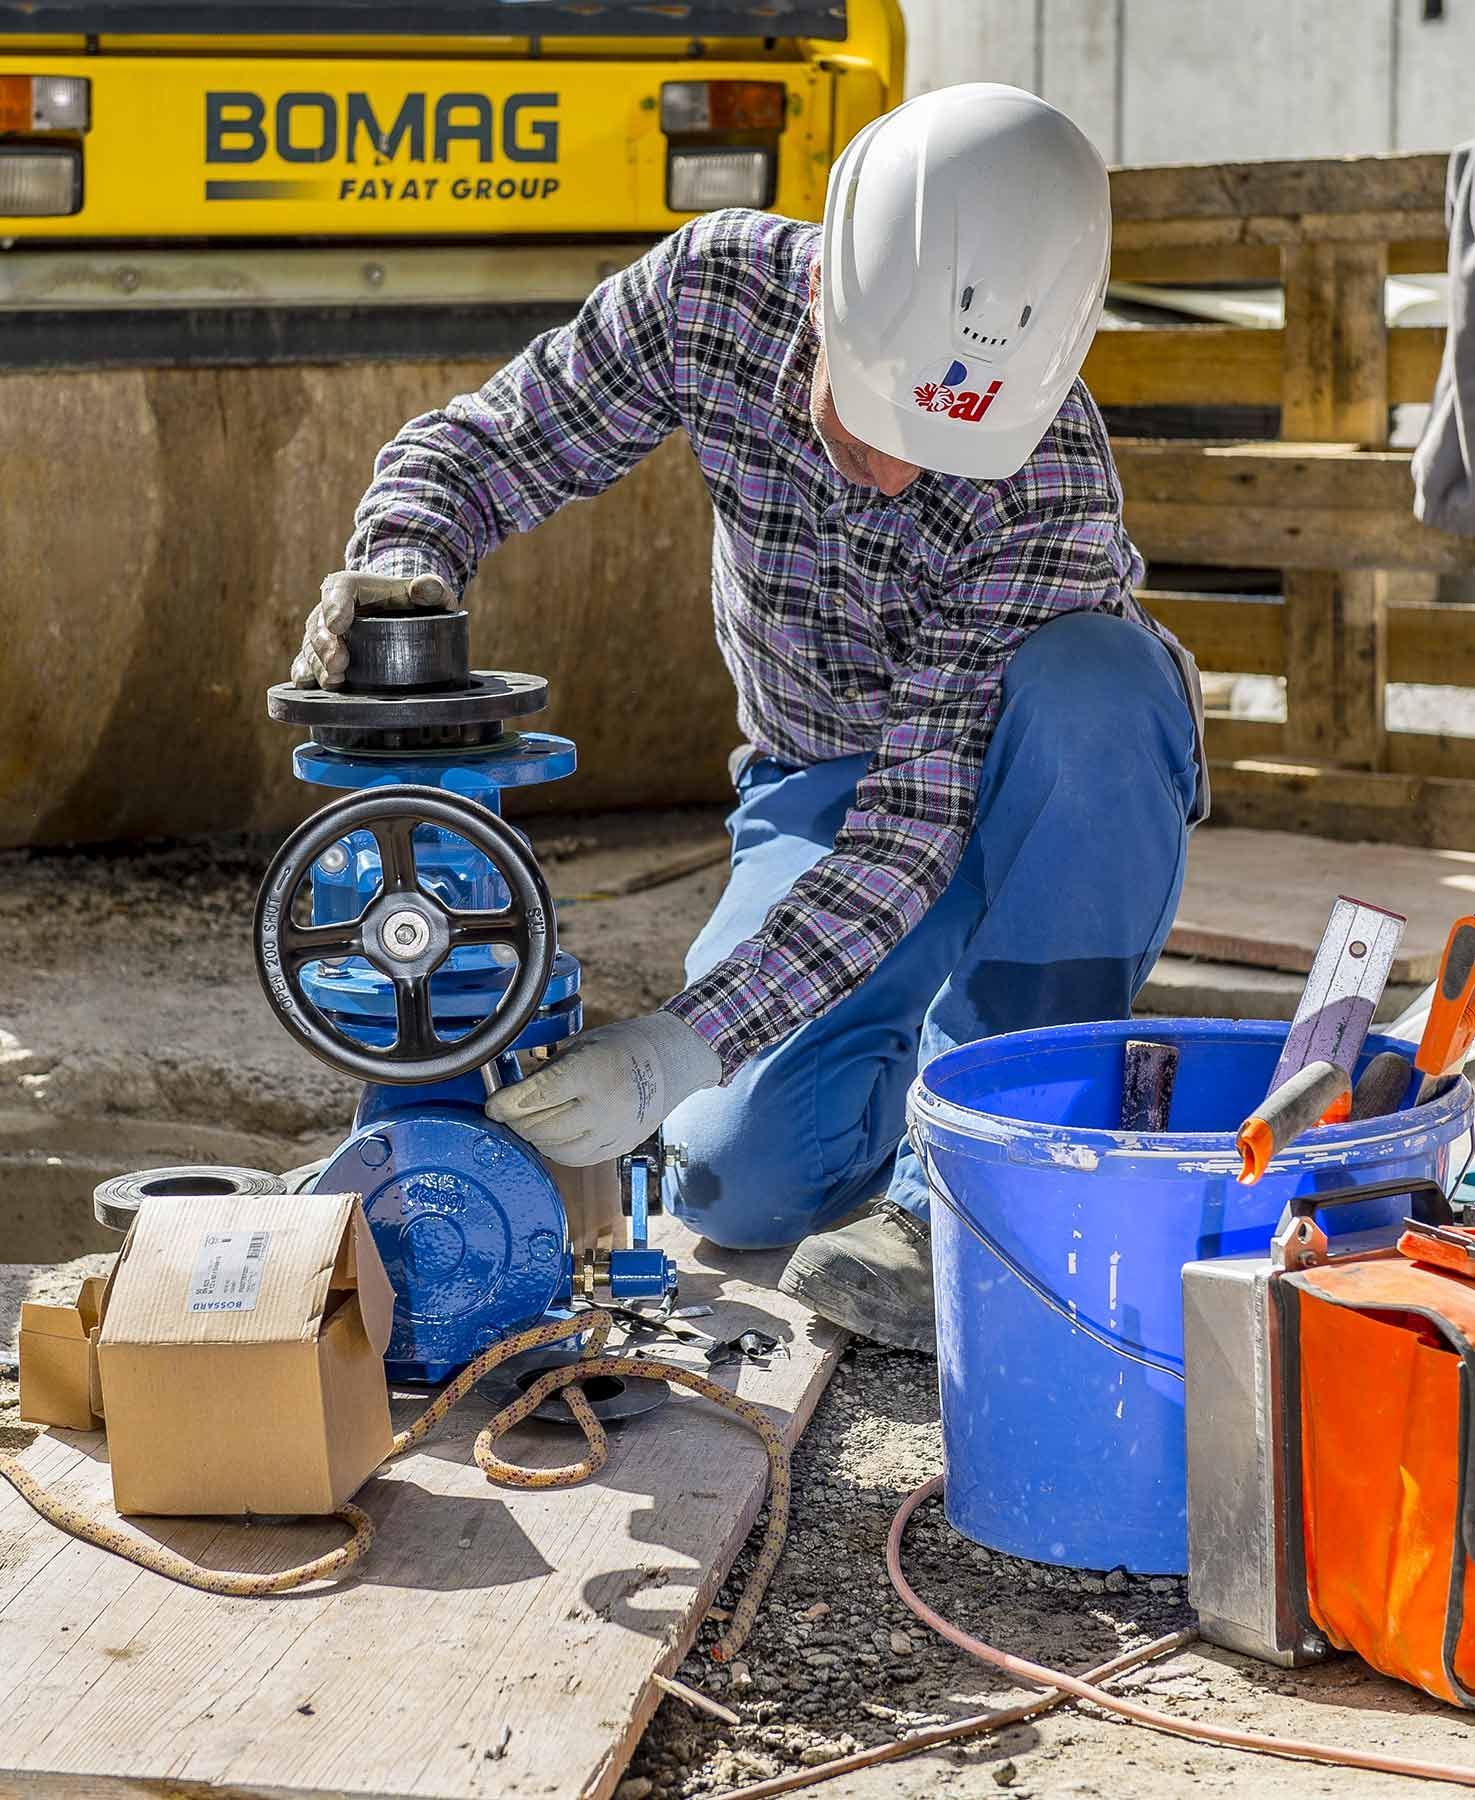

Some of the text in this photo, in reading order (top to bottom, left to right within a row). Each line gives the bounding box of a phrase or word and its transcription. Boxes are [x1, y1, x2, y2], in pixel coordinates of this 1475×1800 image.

[206, 92, 559, 164] BOMAG
[338, 178, 560, 200] FAYAT GROUP
[264, 896, 294, 1010] OPEN 200 SHUT
[193, 1301, 242, 1310] BOSSARD
